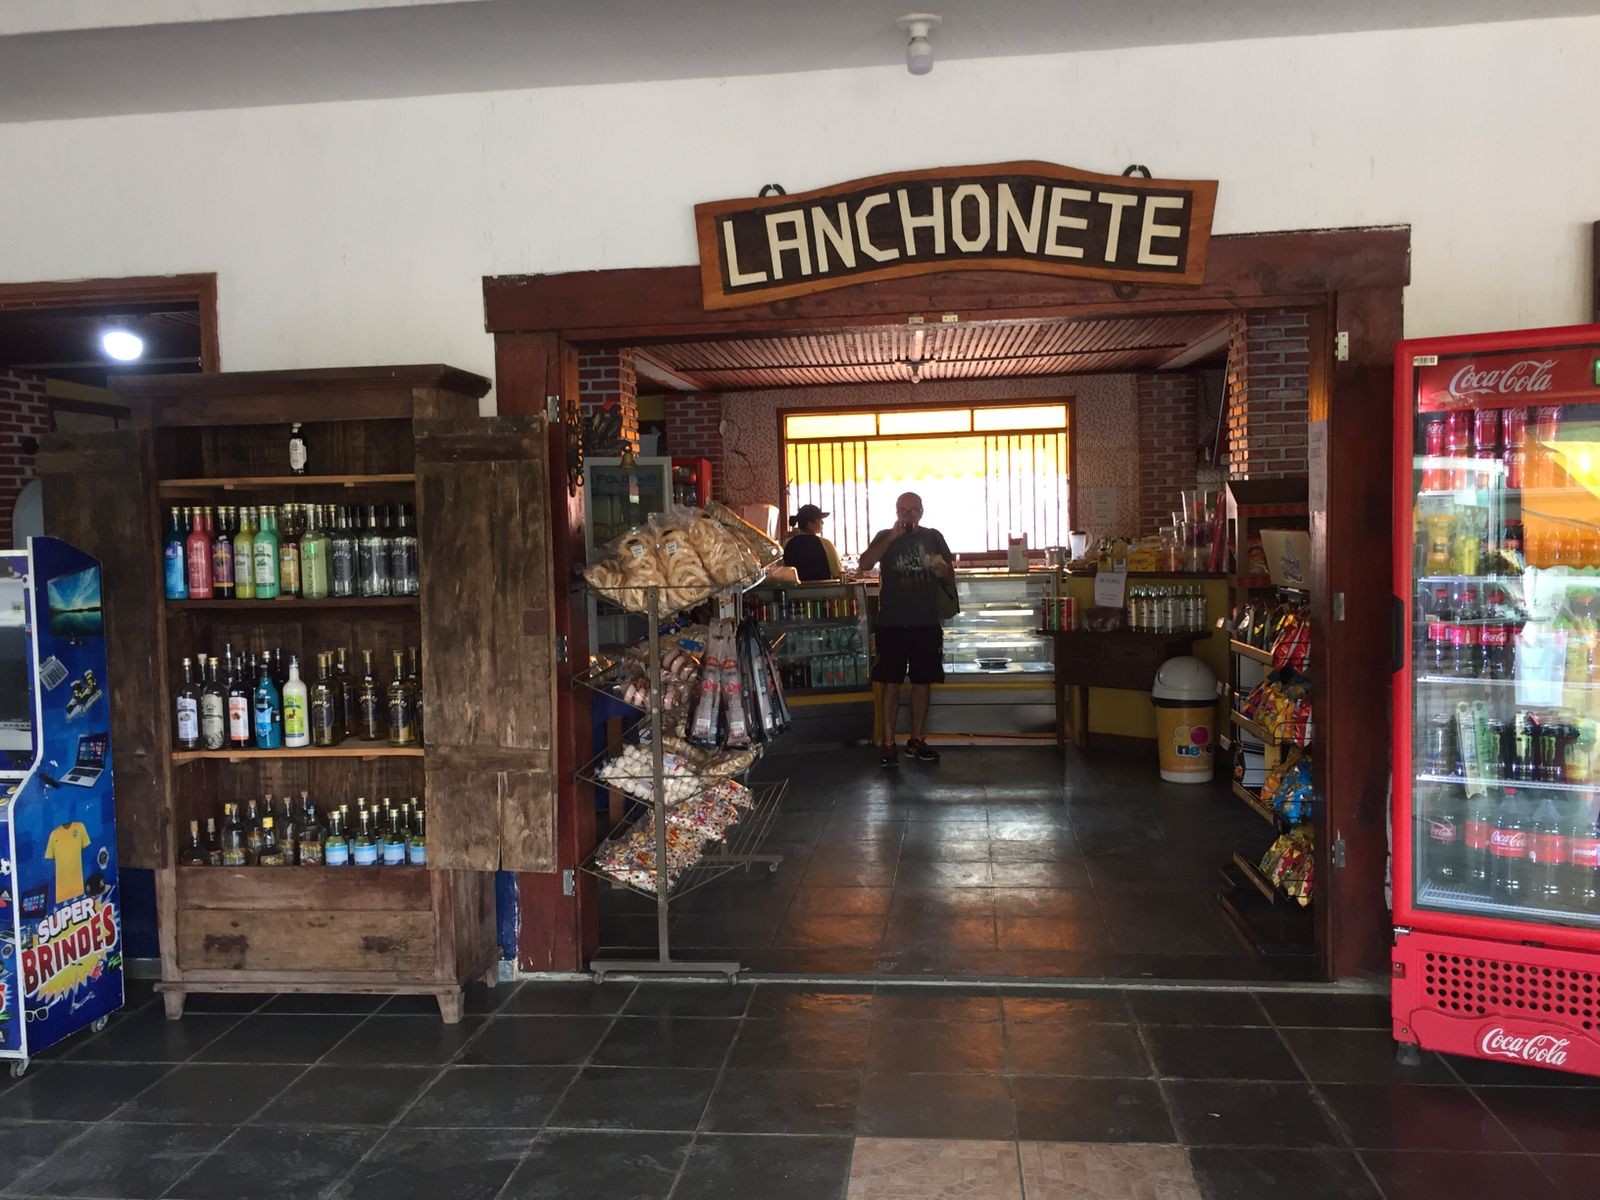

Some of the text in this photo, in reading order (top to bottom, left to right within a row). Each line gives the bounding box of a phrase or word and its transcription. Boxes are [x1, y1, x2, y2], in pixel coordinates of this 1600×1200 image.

[722, 183, 1185, 287] LANCHONETE
[21, 903, 118, 996] BRINDES
[38, 897, 96, 944] SUPER
[1482, 1027, 1571, 1066] Coca-Cola
